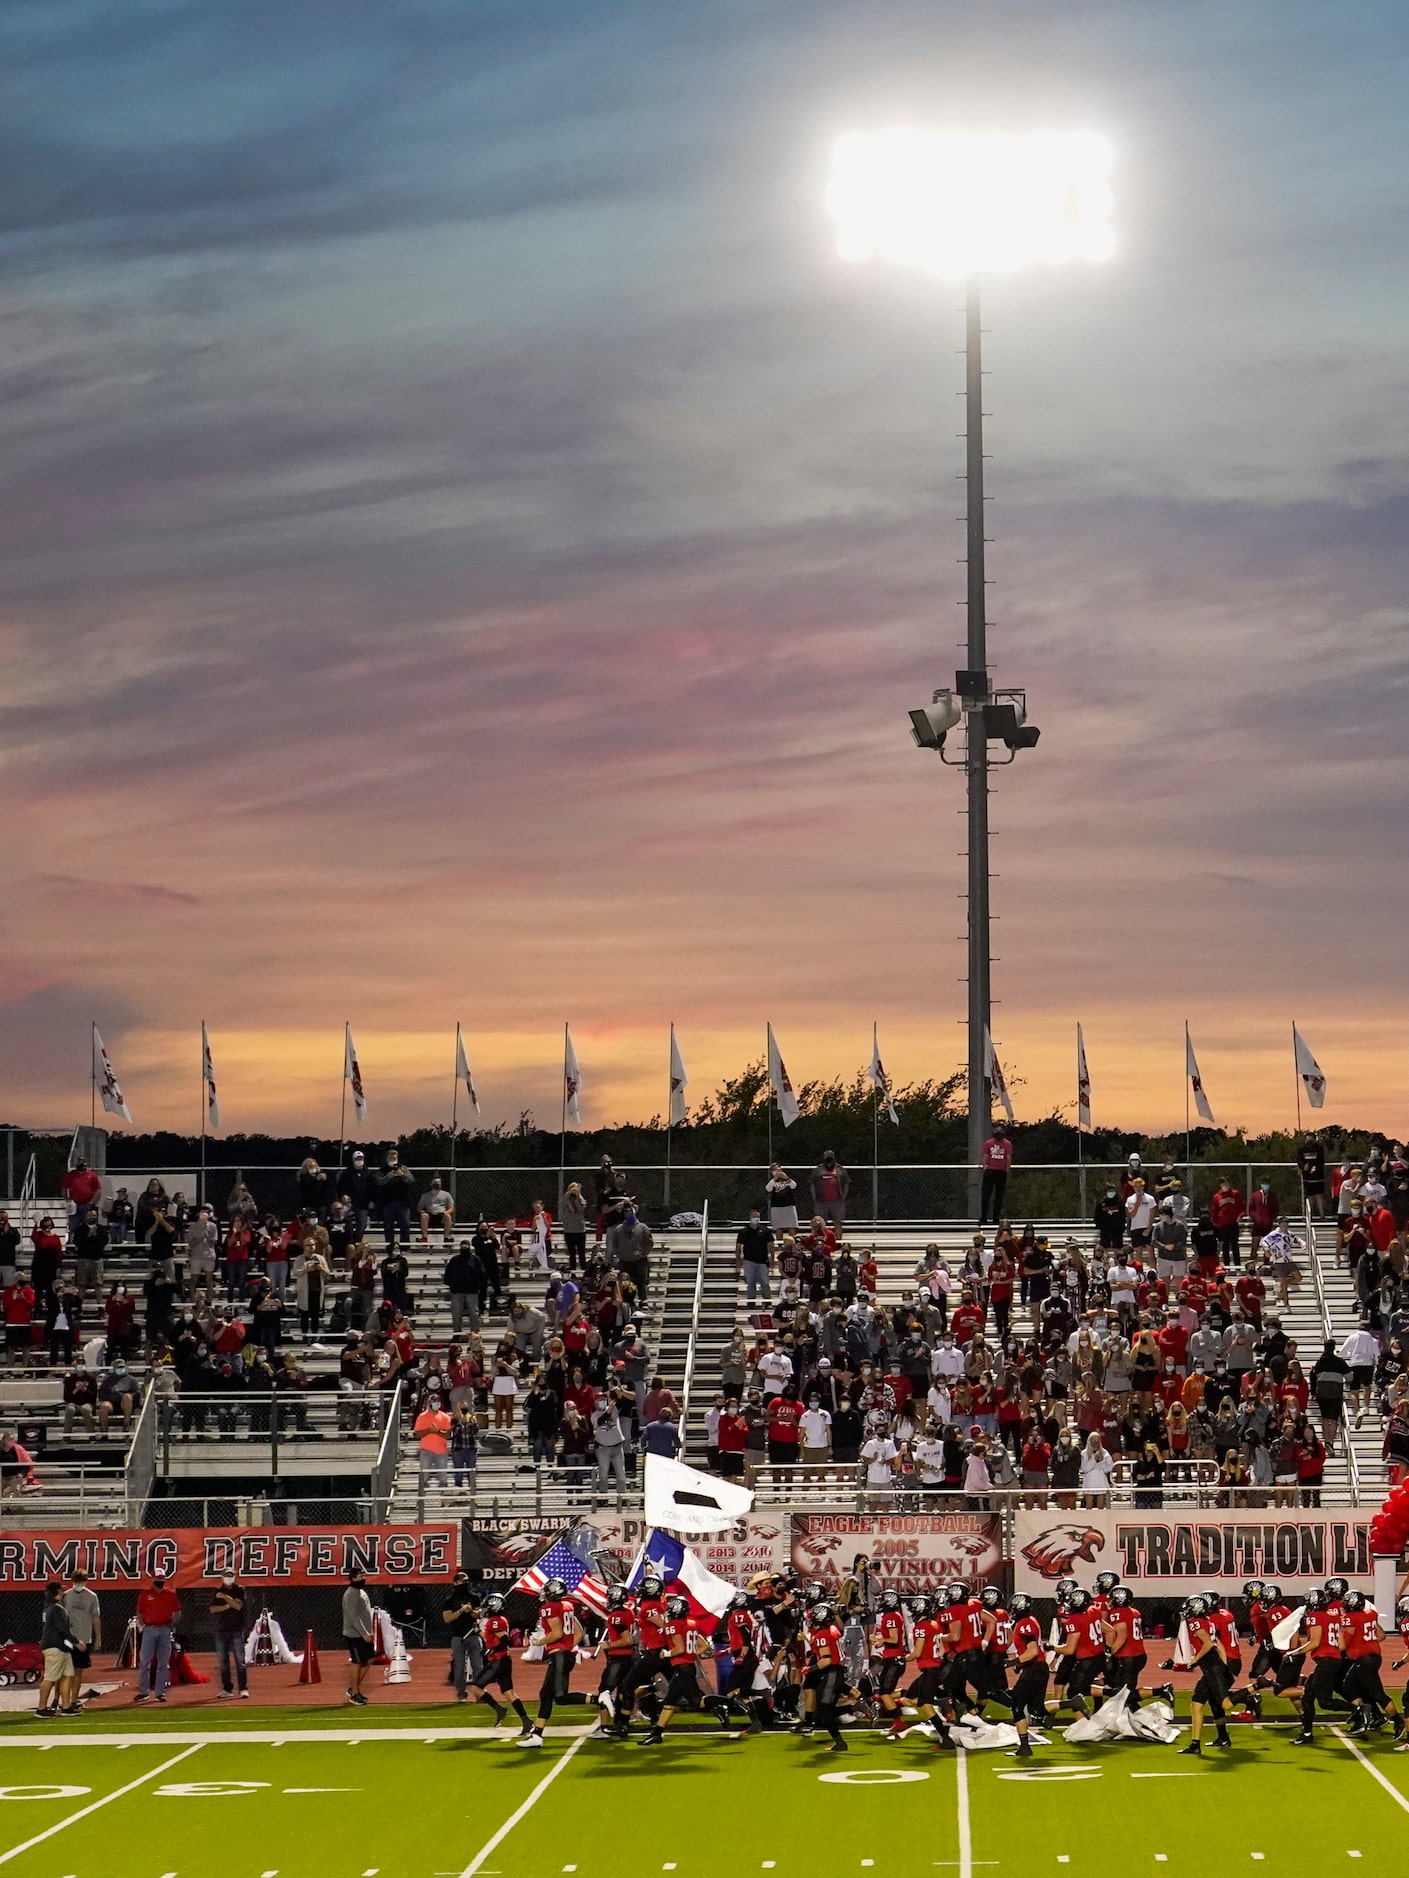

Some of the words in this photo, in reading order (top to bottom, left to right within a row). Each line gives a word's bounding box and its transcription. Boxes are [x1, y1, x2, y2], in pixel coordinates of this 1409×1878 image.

[662, 1510, 683, 1520] COME
[688, 1515, 704, 1524] AND
[472, 1519, 518, 1532] BLACK
[520, 1517, 571, 1531] SWARM
[808, 1515, 872, 1534] EAGLE
[875, 1515, 982, 1534] FOOTBALL
[708, 1547, 736, 1558] 2013
[742, 1546, 772, 1558] 2016
[872, 1538, 920, 1558] 2005
[1117, 1522, 1326, 1577] TRADITION
[203, 1532, 450, 1578] DEFENSE
[708, 1562, 736, 1573] 2014
[742, 1561, 772, 1573] 2017
[811, 1557, 838, 1576] 2A
[968, 1557, 979, 1576] 1
[541, 1607, 552, 1617] 87
[646, 1608, 658, 1617] 75
[1109, 1612, 1120, 1622] 67
[1271, 1611, 1283, 1622] 43
[611, 1616, 621, 1625] 12
[734, 1614, 745, 1623] 17
[886, 1619, 897, 1628] 21
[492, 1620, 499, 1629] 2
[1019, 1624, 1032, 1634] 44
[1189, 1620, 1201, 1632] 23
[914, 1628, 926, 1638] 25
[815, 1637, 827, 1647] 10
